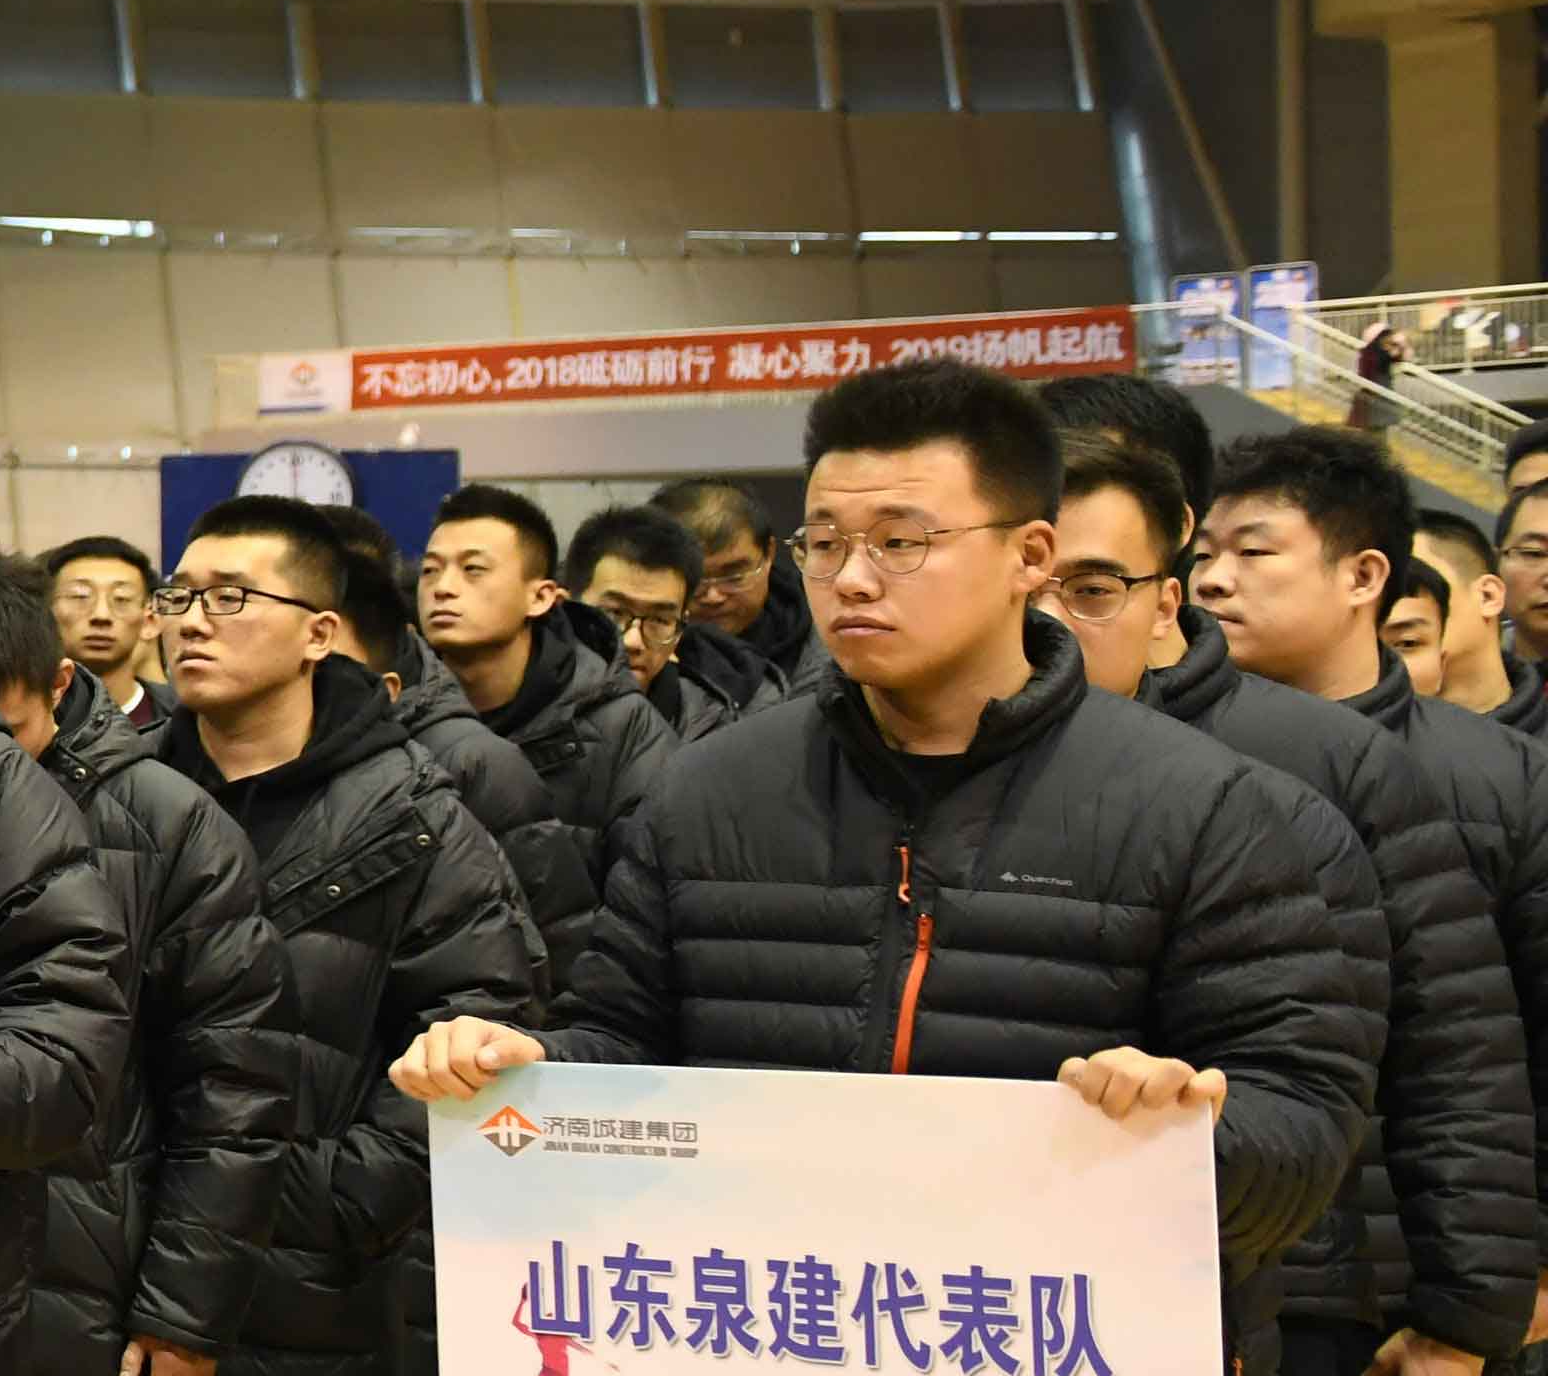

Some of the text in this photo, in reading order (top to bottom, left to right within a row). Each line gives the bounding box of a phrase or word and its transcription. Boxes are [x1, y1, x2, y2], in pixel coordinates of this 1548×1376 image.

[542, 1116, 699, 1143] 济南城建集团
